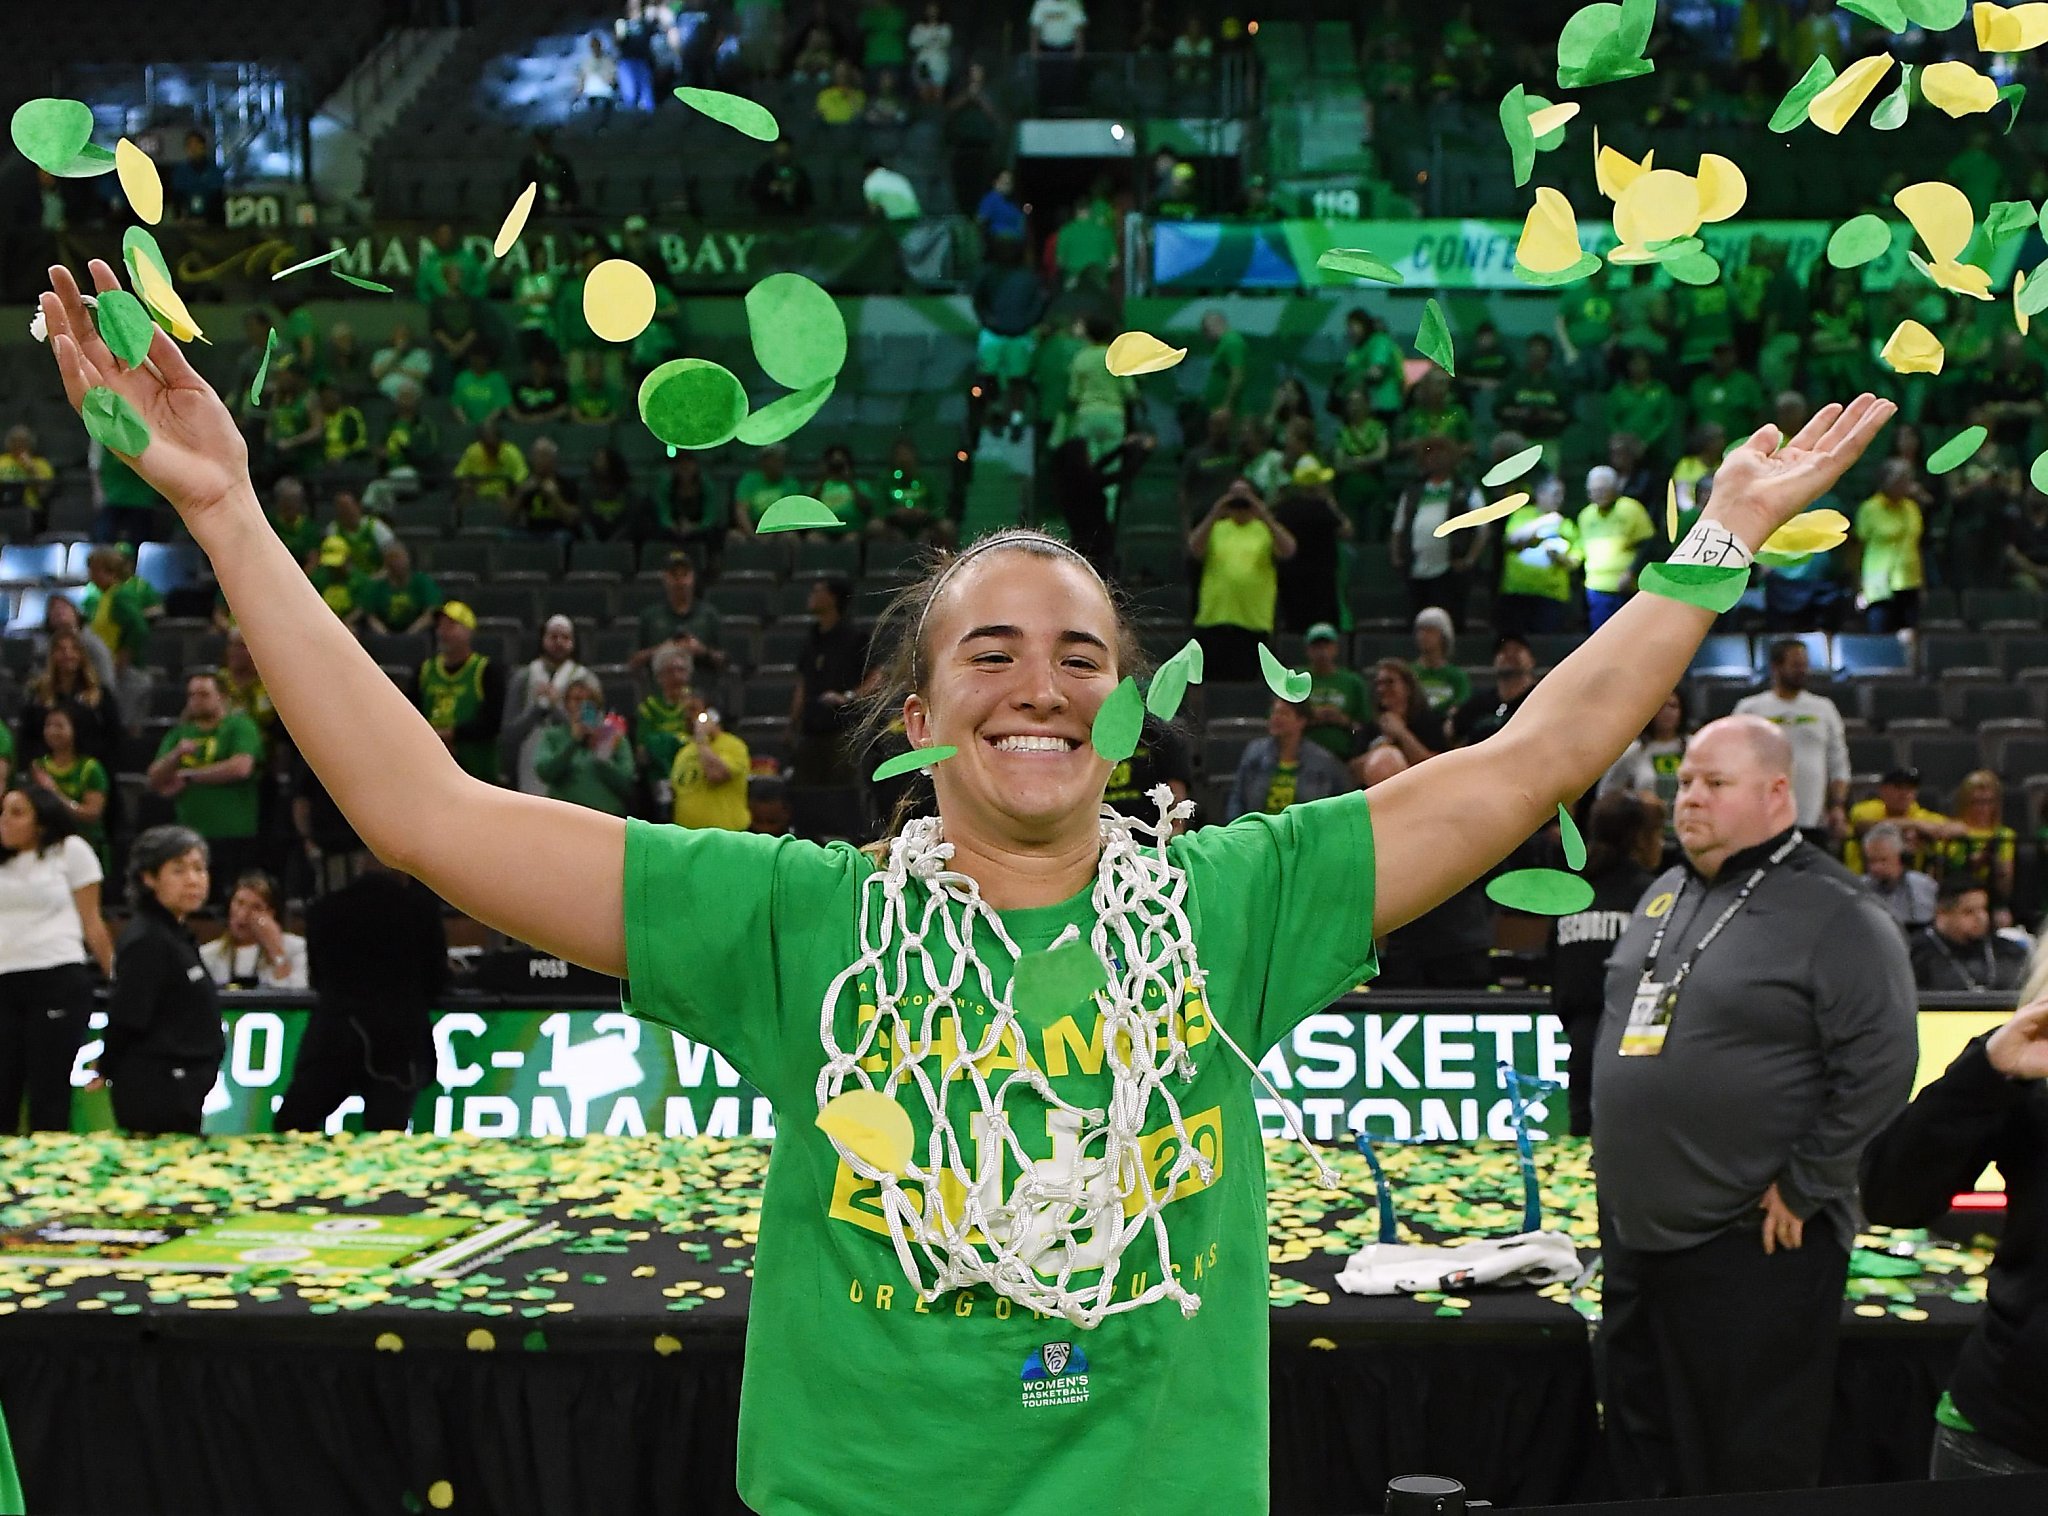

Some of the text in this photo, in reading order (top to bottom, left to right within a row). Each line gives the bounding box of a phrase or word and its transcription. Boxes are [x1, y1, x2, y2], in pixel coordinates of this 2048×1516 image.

[659, 232, 755, 274] BAY
[1110, 1242, 1218, 1300] UCKS
[1022, 1375, 1089, 1392] WOMEN'S
[1021, 1386, 1090, 1401] BASKETBALL
[1021, 1394, 1090, 1408] TOURNAMENT
